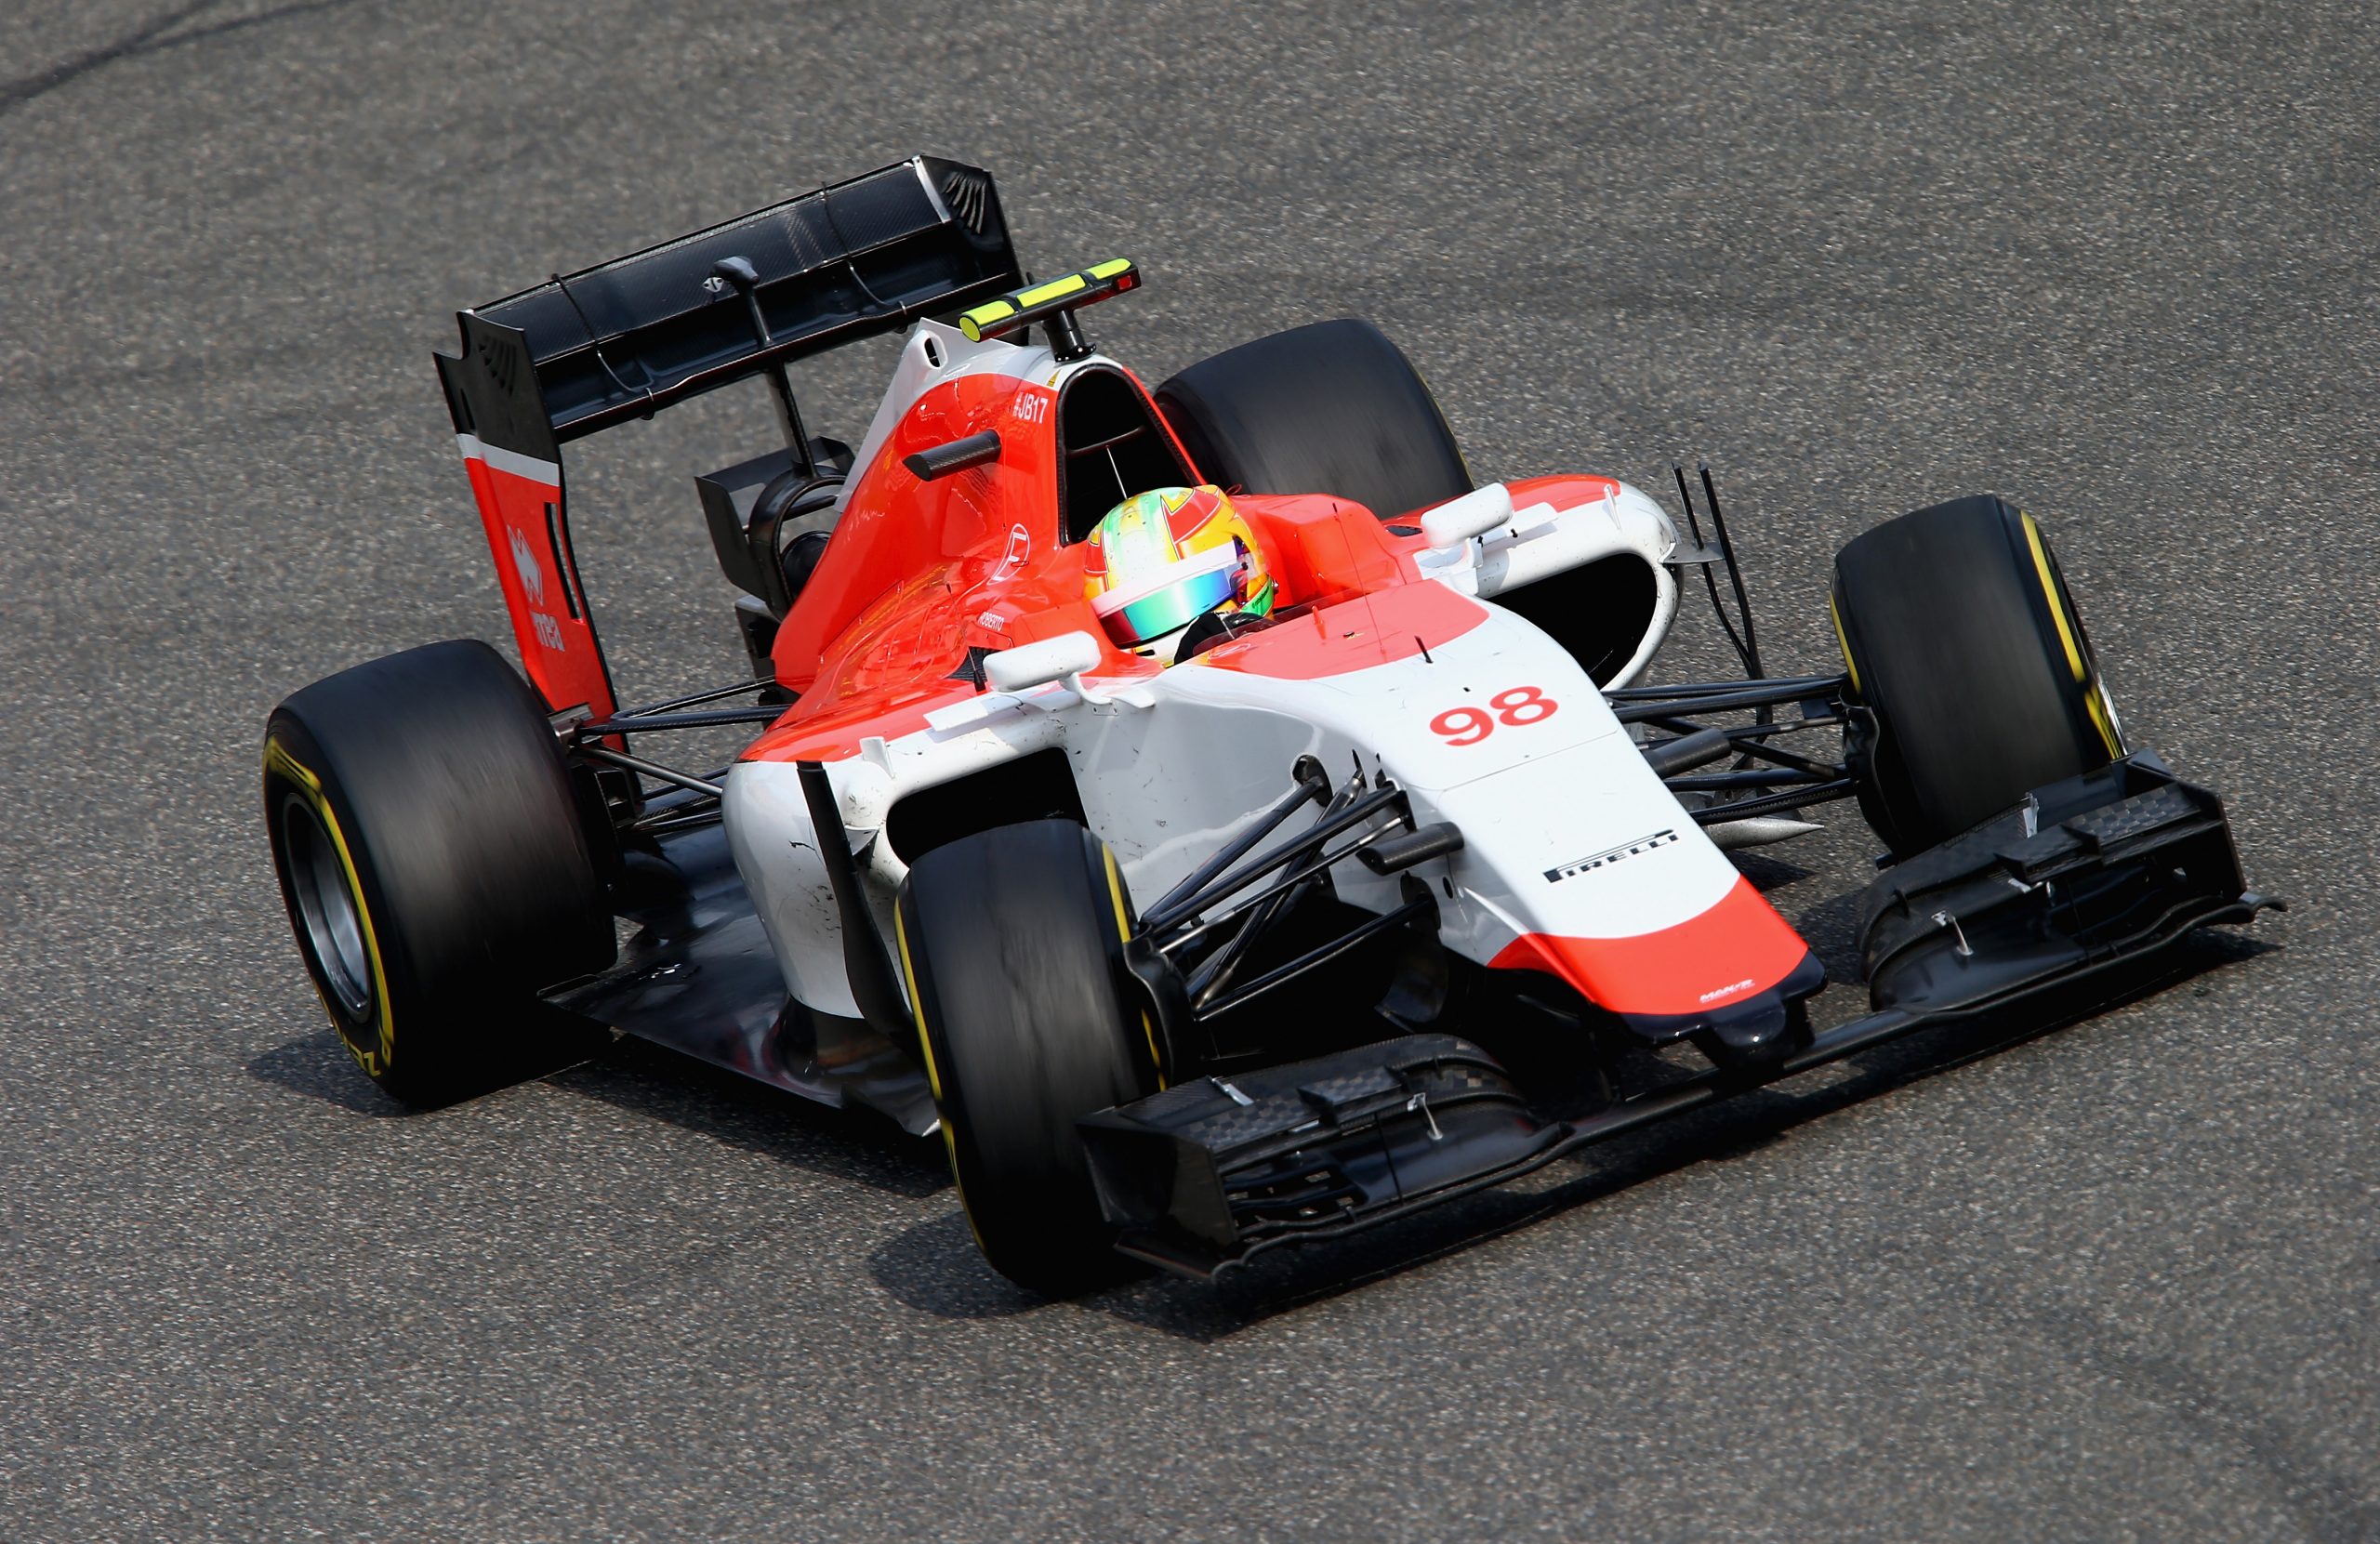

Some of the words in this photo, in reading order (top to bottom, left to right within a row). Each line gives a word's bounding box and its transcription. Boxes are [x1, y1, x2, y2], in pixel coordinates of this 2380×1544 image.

[1012, 391, 1049, 424] #JB17
[977, 611, 1005, 632] ROBERTO
[1430, 686, 1558, 746] 98
[1543, 829, 1679, 883] PIRELLI
